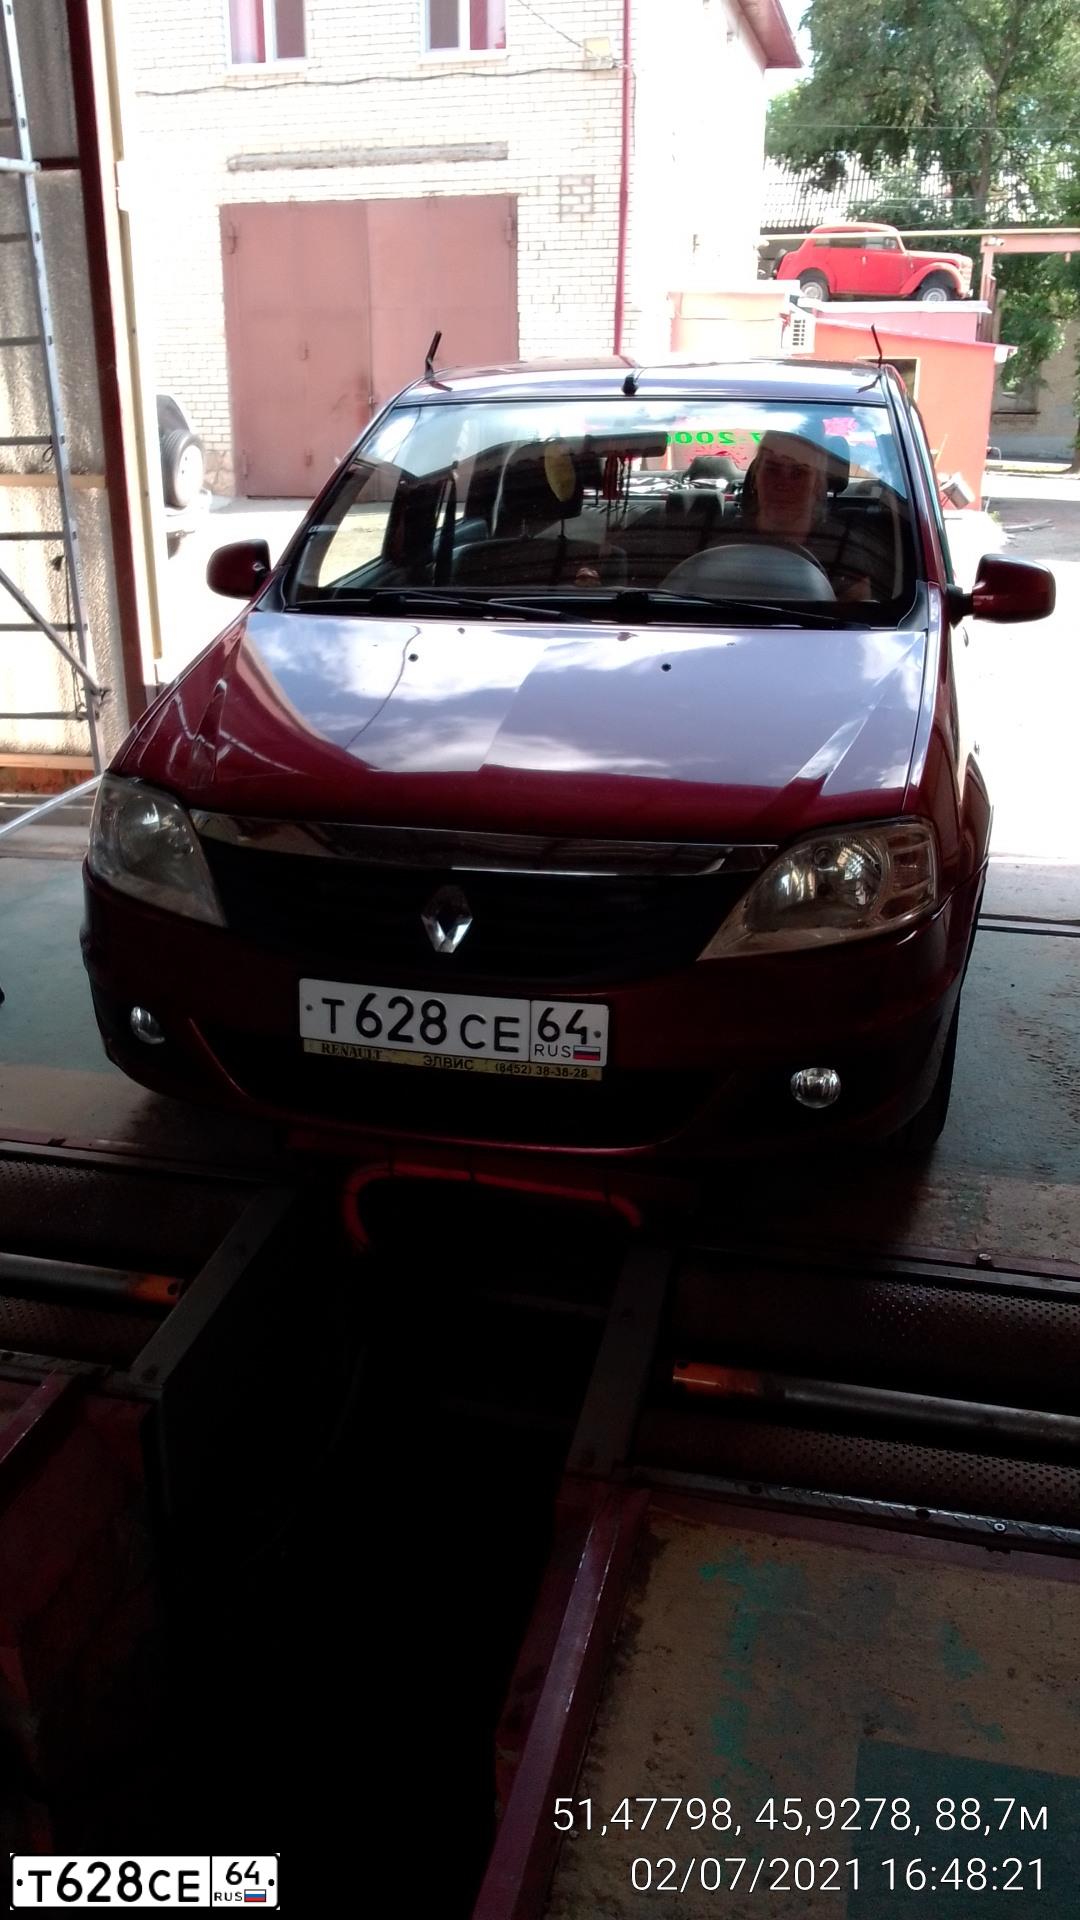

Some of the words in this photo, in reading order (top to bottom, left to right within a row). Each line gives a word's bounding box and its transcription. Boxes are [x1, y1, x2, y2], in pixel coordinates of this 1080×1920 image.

[538, 1007, 588, 1045] 64
[321, 1042, 382, 1061] RENAULT
[534, 1044, 571, 1058] RUS
[423, 1054, 474, 1071] ЭЛВИС
[495, 1062, 532, 1075] (8452)
[536, 1066, 589, 1079] 38-38-28
